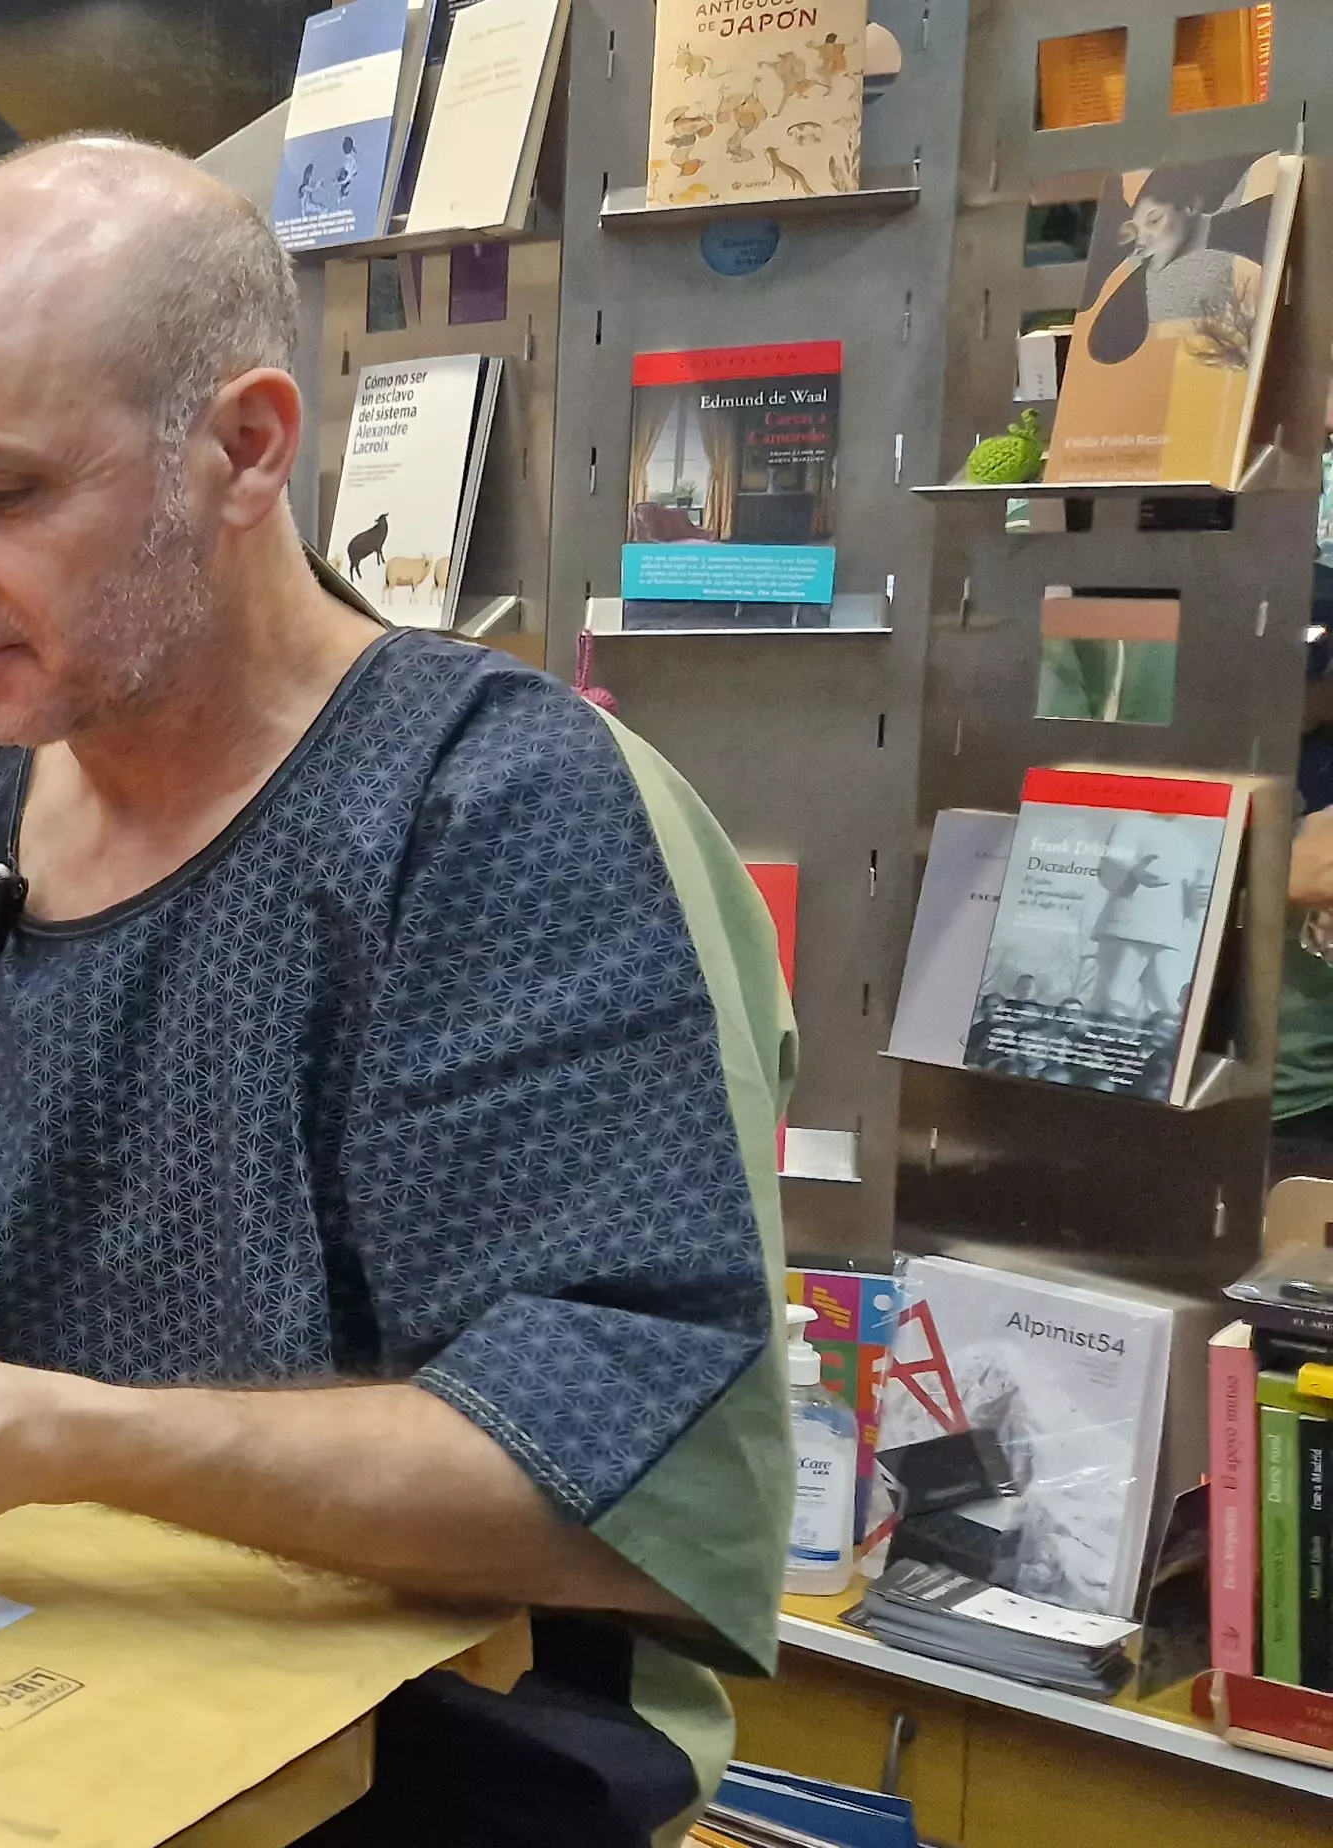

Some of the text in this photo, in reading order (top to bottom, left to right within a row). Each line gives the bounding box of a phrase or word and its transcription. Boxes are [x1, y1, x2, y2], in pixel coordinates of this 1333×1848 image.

[698, 8, 817, 37] DE JAPÓN
[364, 371, 428, 390] Cómo no ser
[361, 388, 414, 406] un esclavo
[700, 387, 828, 410] Edmund de Waal
[358, 405, 418, 423] del sistema
[355, 422, 408, 440] Alexandre
[352, 438, 390, 455] Lacroix
[1030, 836, 1069, 854] Frank
[1223, 1427, 1244, 1473] apoyo
[1309, 1448, 1323, 1483] Madrid
